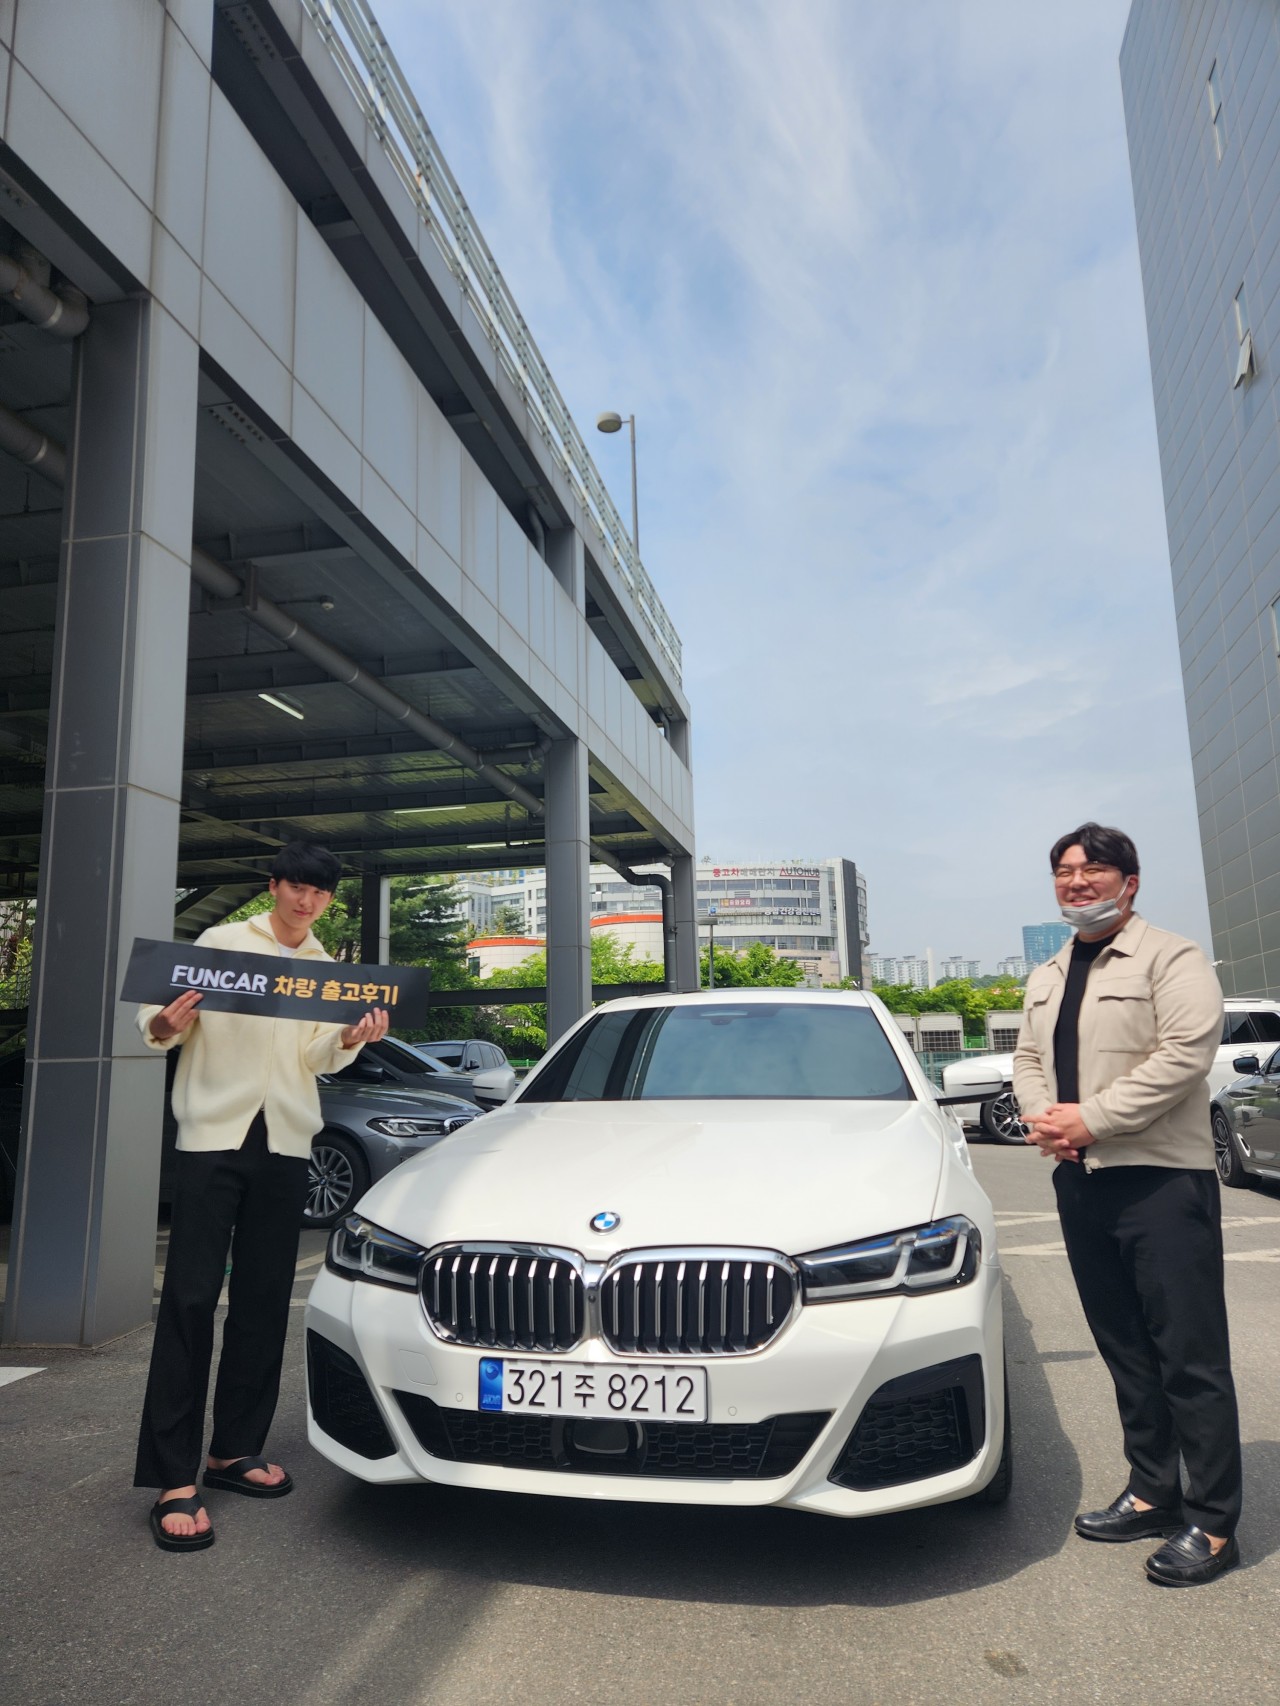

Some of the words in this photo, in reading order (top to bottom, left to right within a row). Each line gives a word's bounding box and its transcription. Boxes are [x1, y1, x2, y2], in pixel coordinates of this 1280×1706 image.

[780, 867, 820, 878] AUTOHUB
[171, 965, 268, 993] FUNCAR
[273, 975, 317, 998] 차량
[321, 979, 398, 1005] 출고후기
[507, 1369, 595, 1408] 321주
[608, 1374, 694, 1414] 8212
